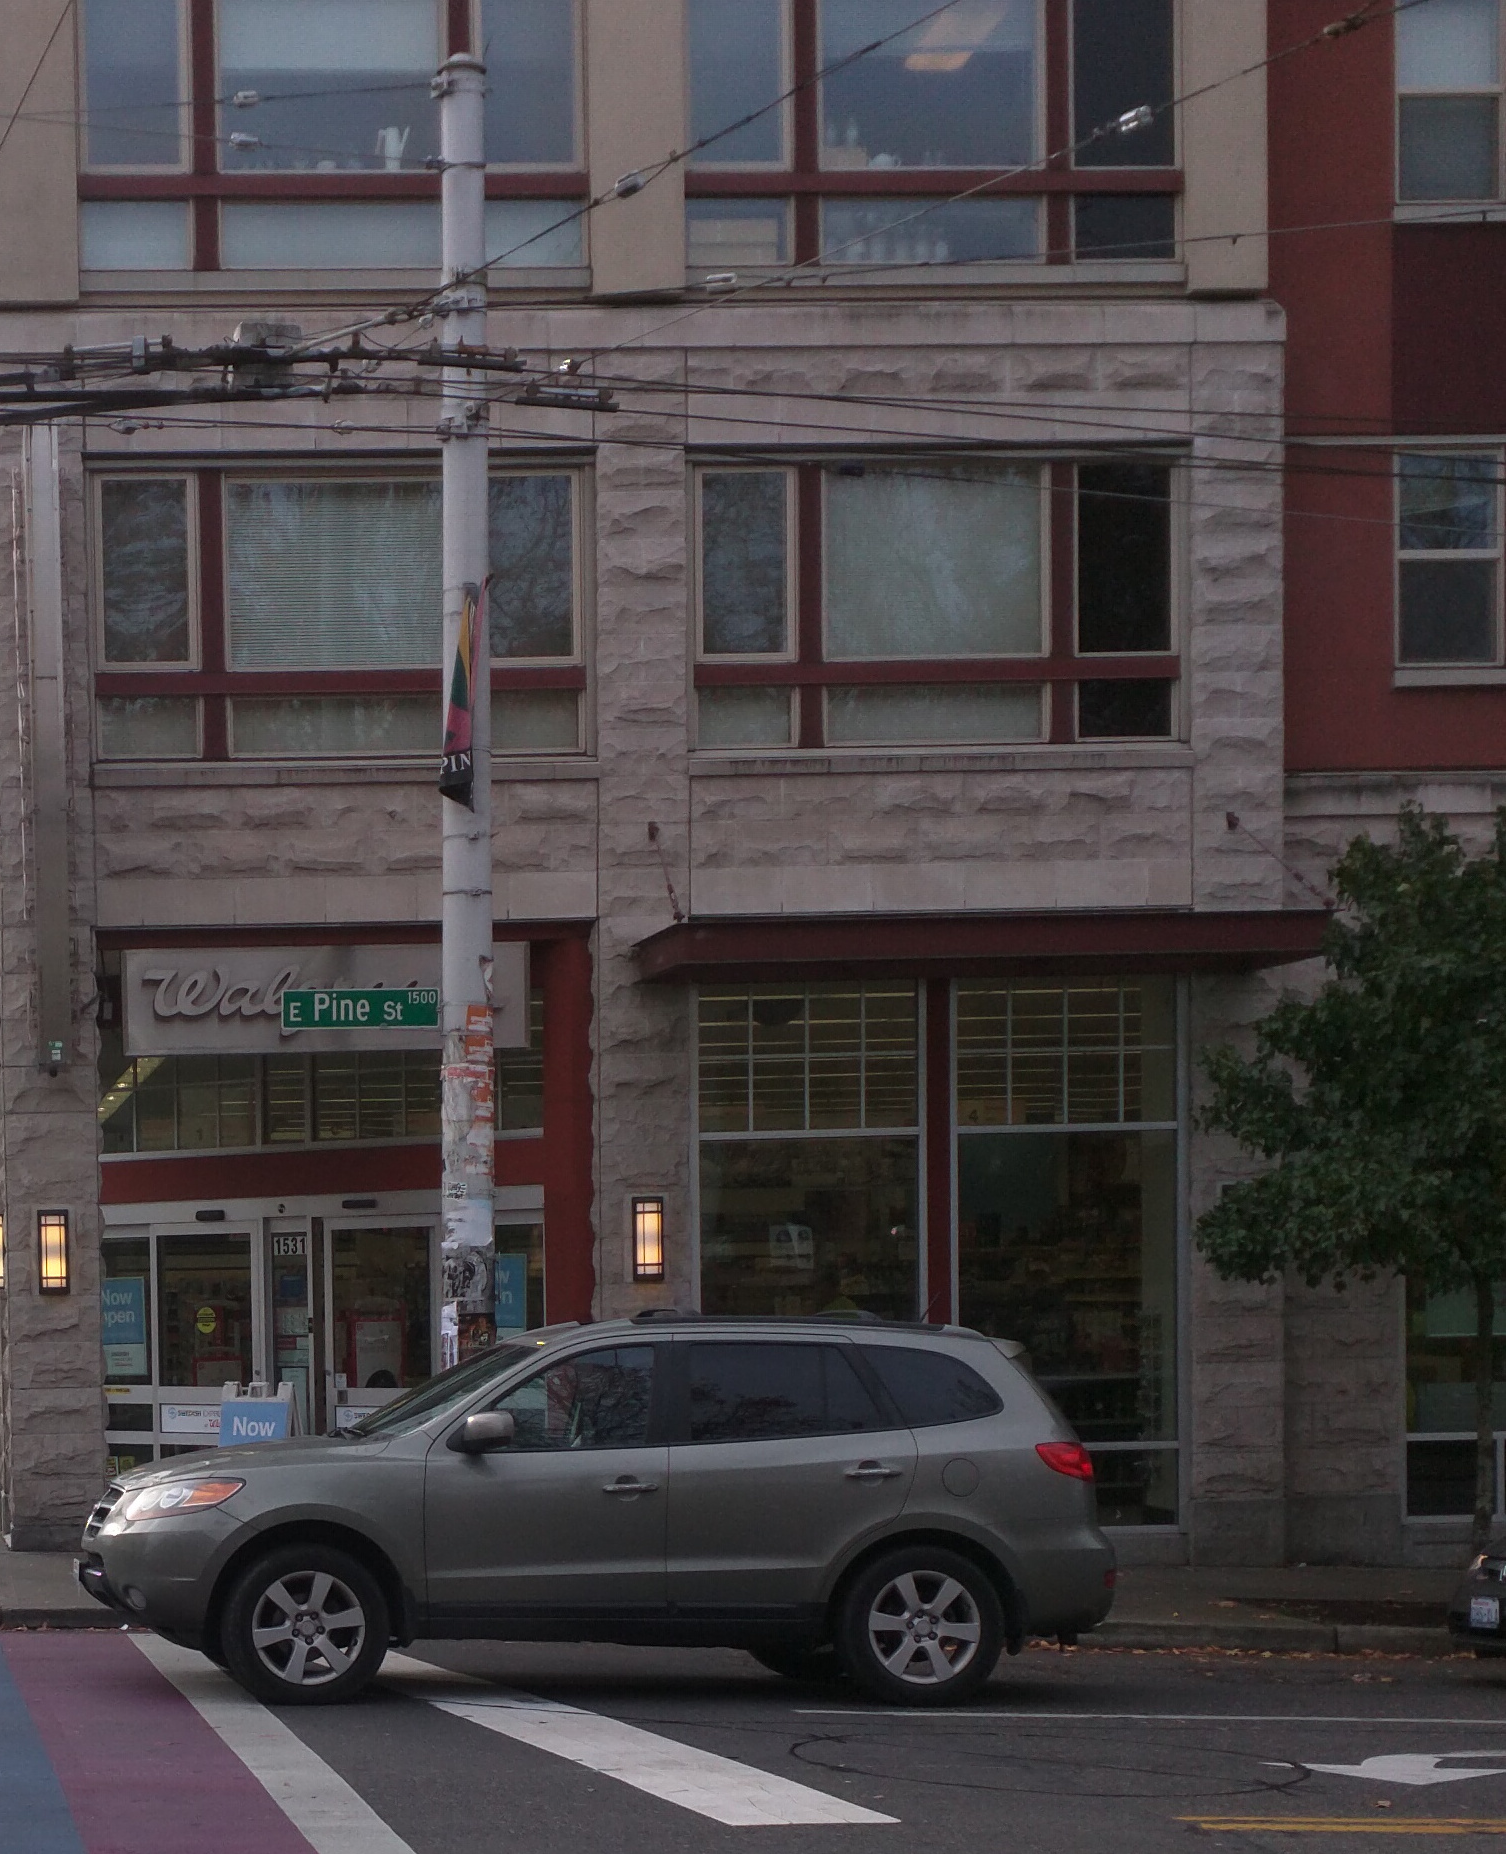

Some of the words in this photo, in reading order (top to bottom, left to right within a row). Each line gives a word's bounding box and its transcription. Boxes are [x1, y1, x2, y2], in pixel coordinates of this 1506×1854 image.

[289, 1002, 302, 1022] E
[314, 993, 370, 1021] Pine
[383, 1002, 404, 1021] St
[408, 991, 436, 1005] 1500
[276, 1237, 306, 1255] 1531
[102, 1290, 133, 1306] Now
[104, 1311, 135, 1328] pen
[232, 1416, 276, 1437] Now
